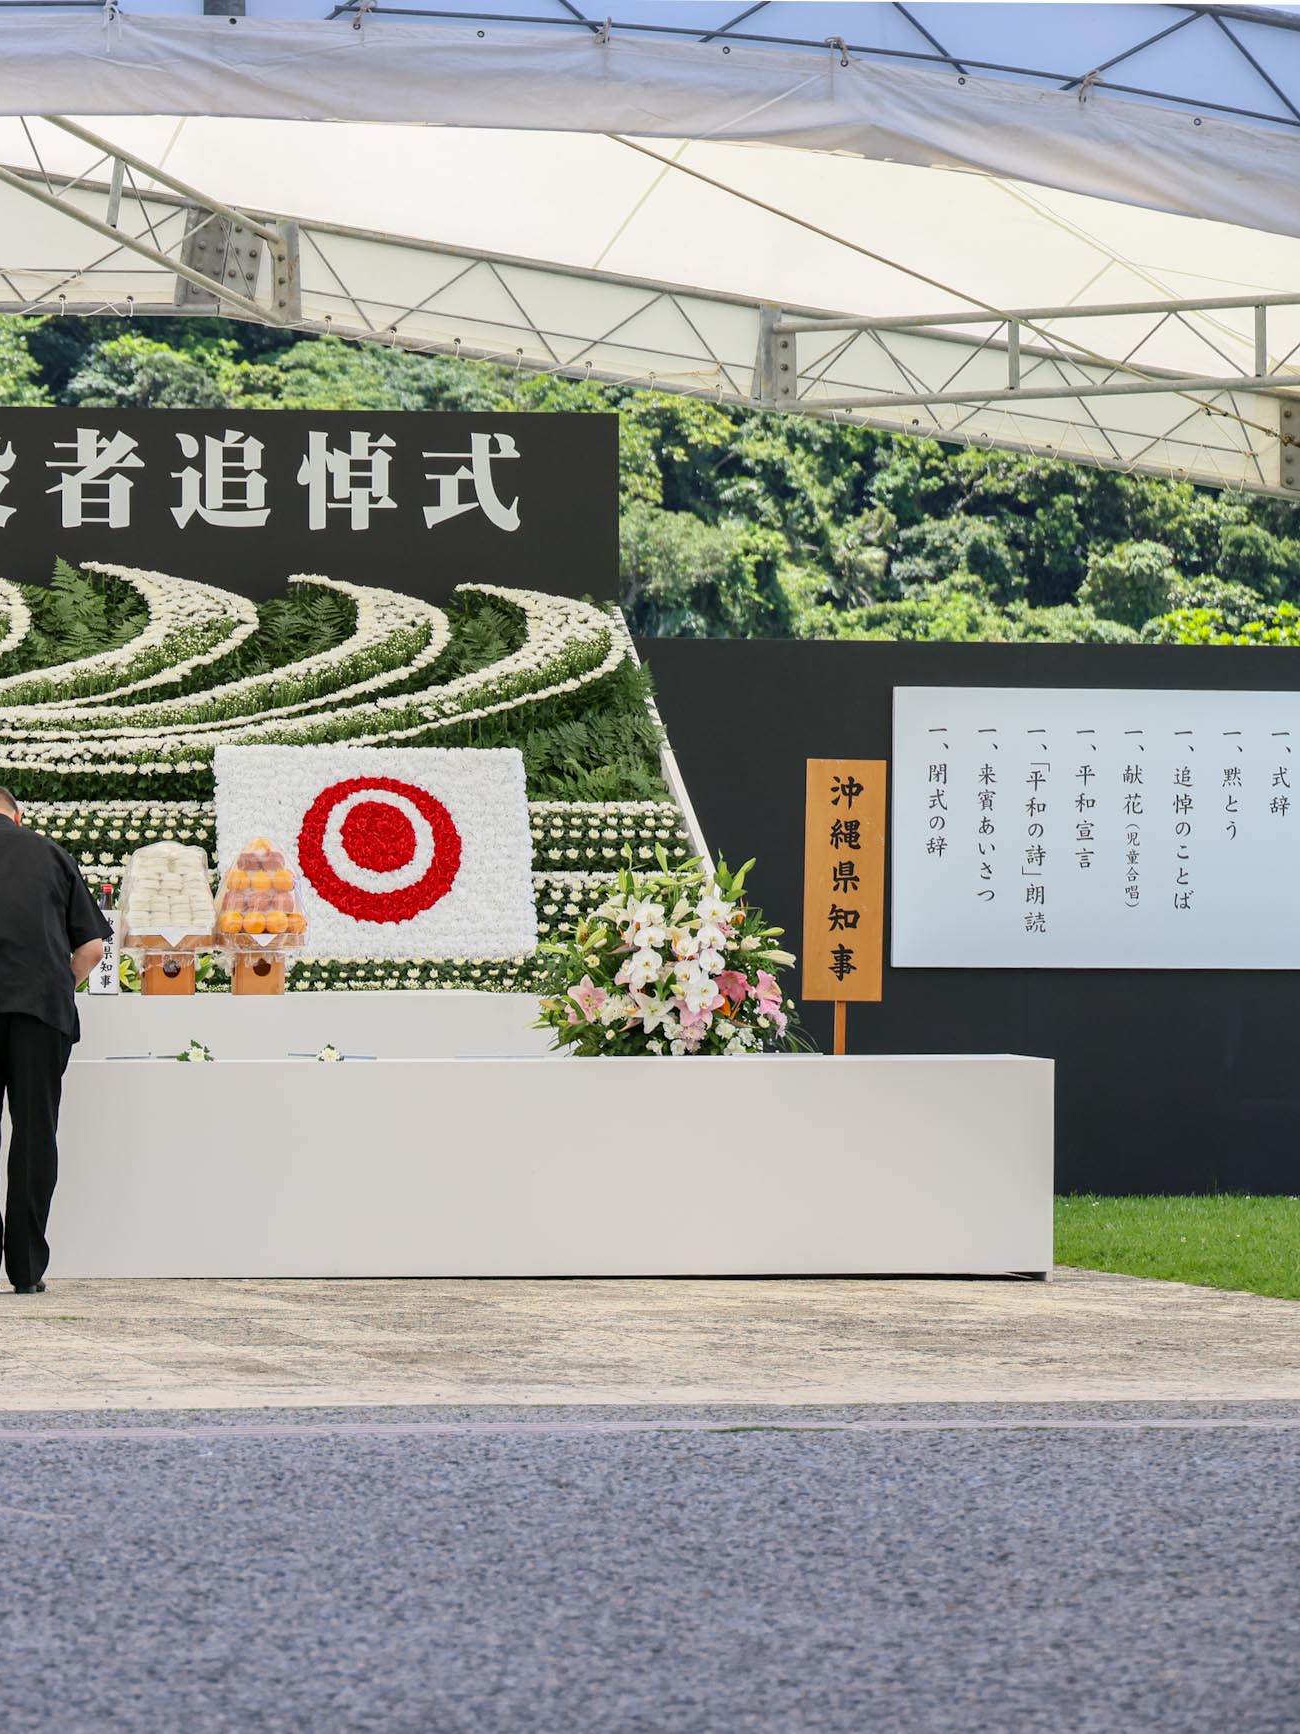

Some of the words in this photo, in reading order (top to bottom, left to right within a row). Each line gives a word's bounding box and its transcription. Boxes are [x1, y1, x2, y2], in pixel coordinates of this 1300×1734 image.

[827, 775, 864, 982] 沖縄県知事
